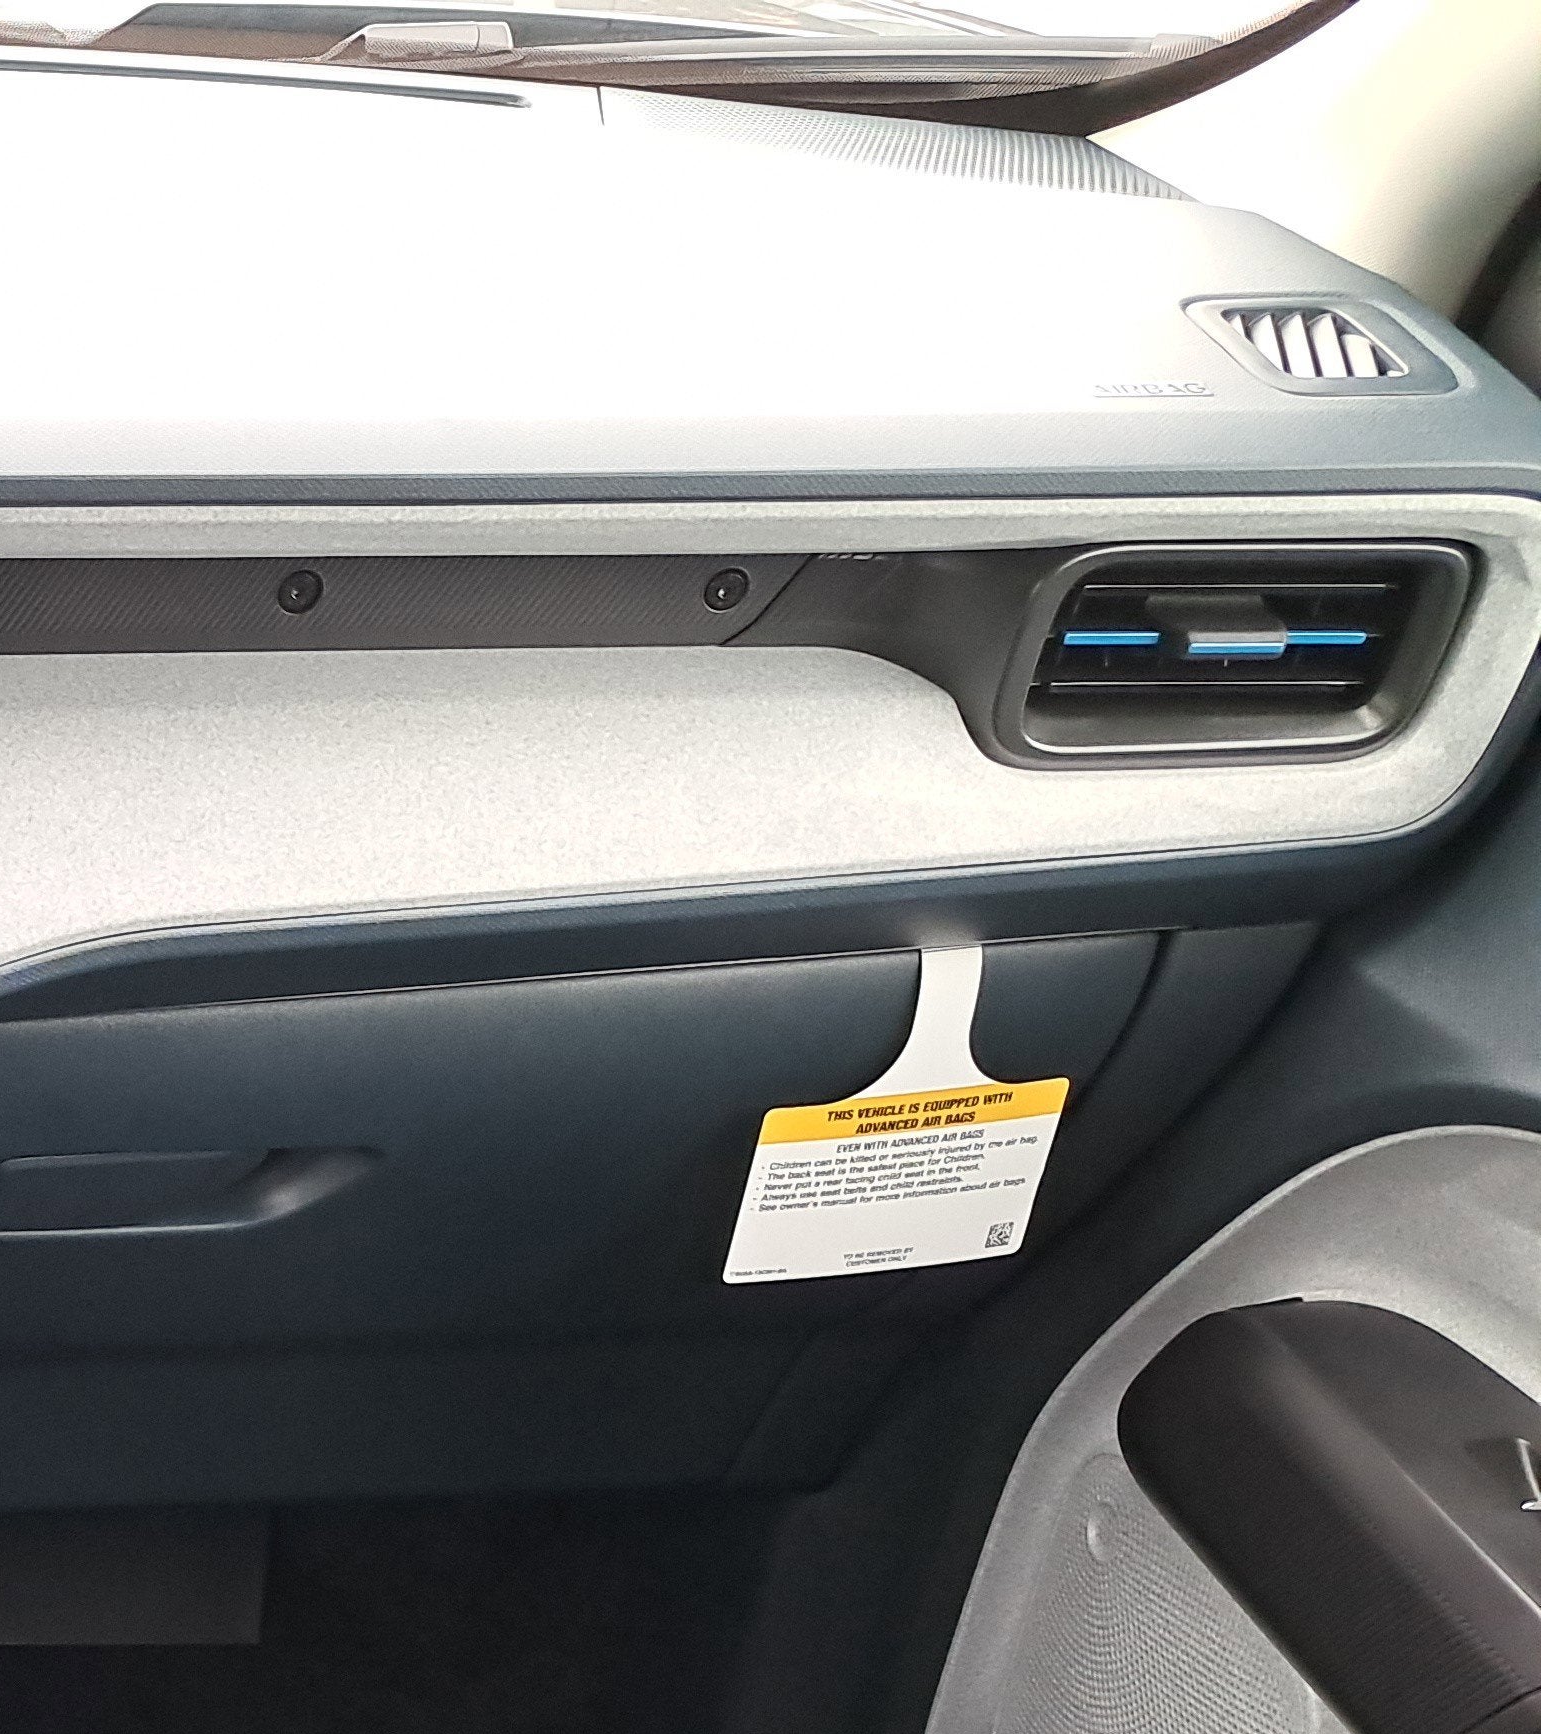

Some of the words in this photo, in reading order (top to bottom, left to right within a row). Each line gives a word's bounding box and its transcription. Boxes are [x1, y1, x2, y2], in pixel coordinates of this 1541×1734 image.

[1094, 382, 1207, 395] AIRBAG
[825, 1109, 854, 1122] THIS
[856, 1104, 905, 1119] VEHICLE
[907, 1102, 920, 1114] IS
[922, 1096, 980, 1112] EQUIPPED
[982, 1091, 1013, 1105] WITH
[855, 1117, 919, 1134] ADVANCED
[921, 1115, 942, 1127] AIR
[944, 1111, 976, 1124] BAGS
[836, 1142, 861, 1153] EVEN
[863, 1139, 888, 1151] WITH
[889, 1134, 940, 1148] ADVANCED
[940, 1132, 958, 1142] AIR
